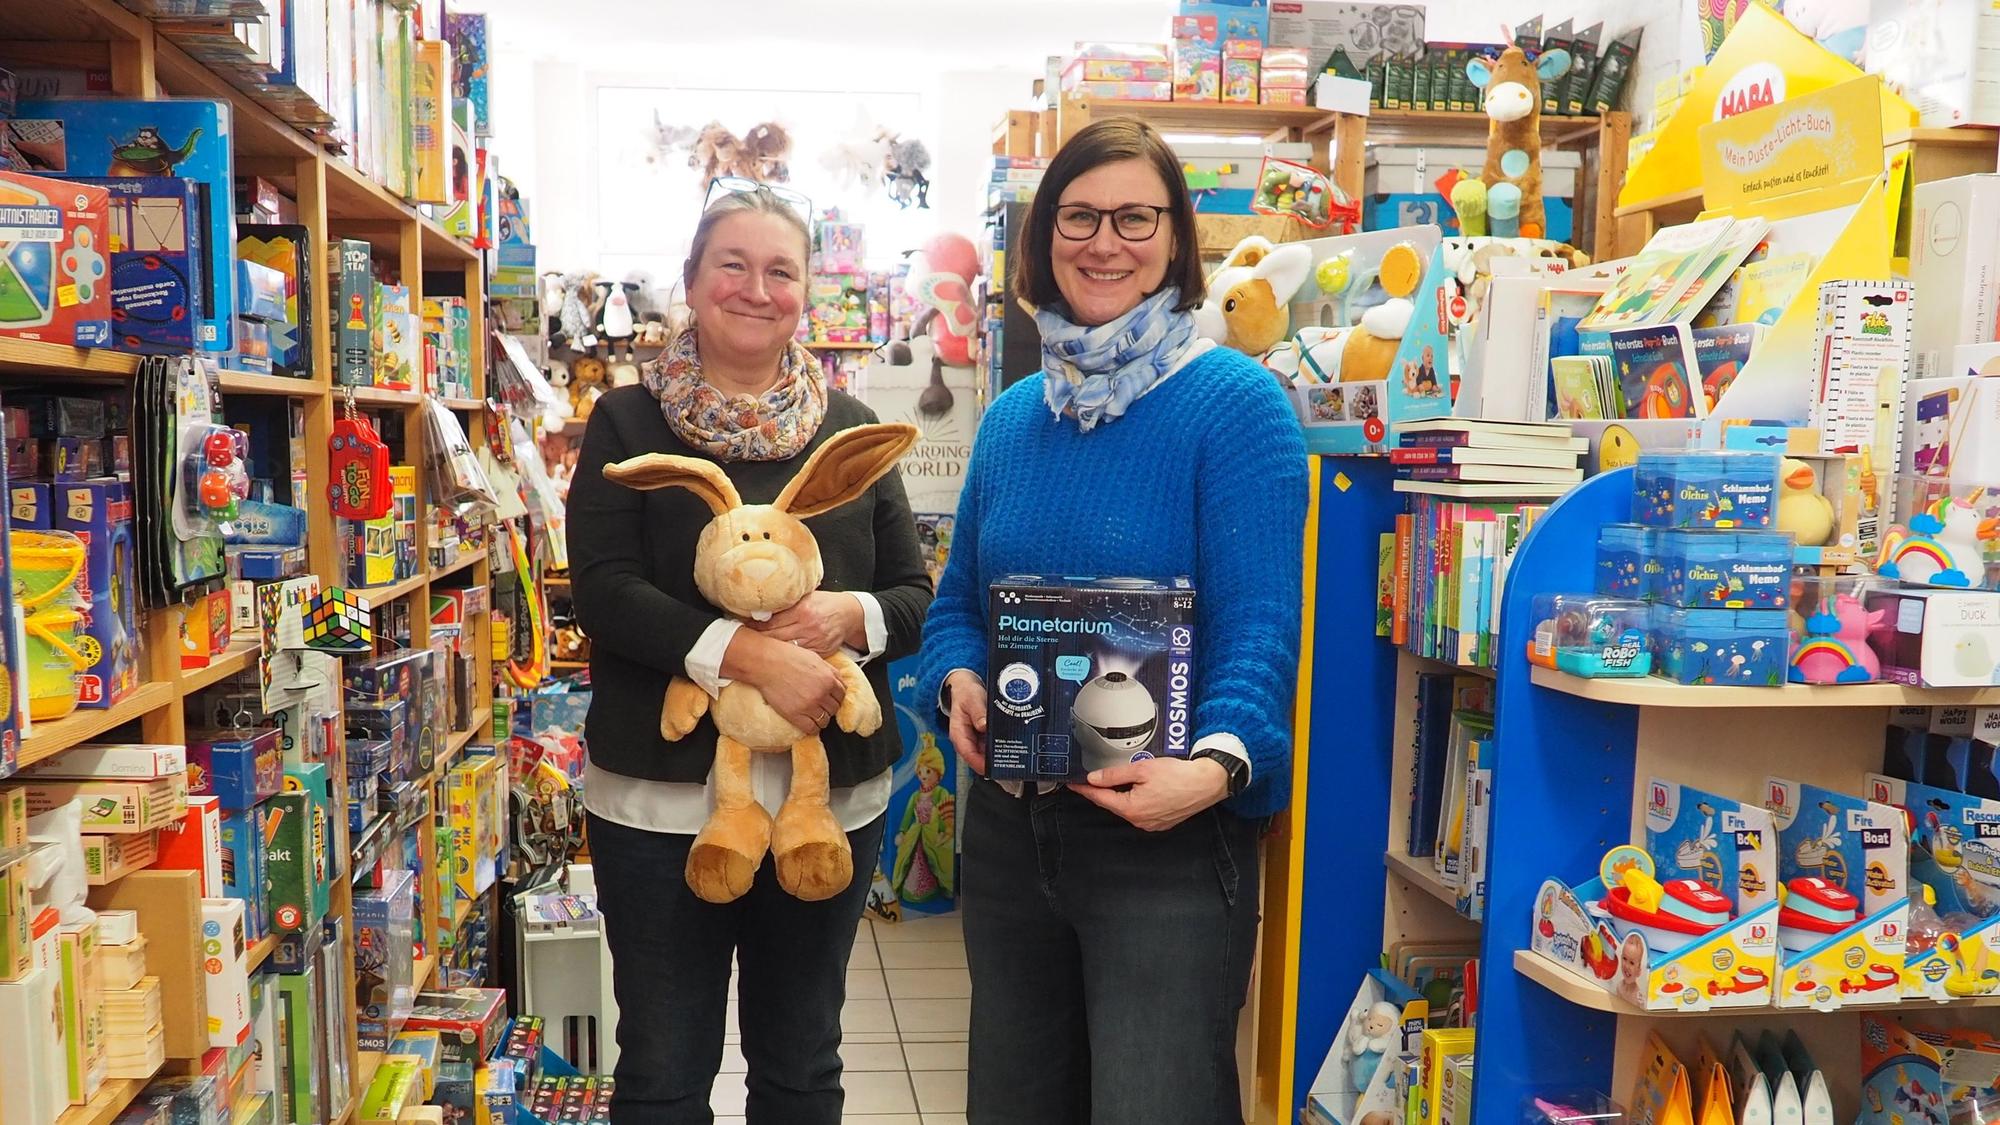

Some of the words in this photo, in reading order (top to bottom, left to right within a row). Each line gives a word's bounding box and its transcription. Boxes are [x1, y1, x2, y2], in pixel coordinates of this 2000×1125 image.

[1721, 78, 1775, 119] HABA
[1725, 146, 1746, 168] Mein
[1747, 114, 1832, 166] Puste-Licht-Buch
[1742, 180, 1762, 193] Einfach
[1783, 173, 1795, 184] und
[1796, 170, 1802, 182] es
[345, 250, 368, 262] TOP
[347, 261, 365, 272] TEN
[1547, 263, 1565, 275] HABA
[1978, 265, 1988, 297] wooden
[1976, 298, 1987, 318] rack
[1975, 319, 1984, 332] for
[1627, 338, 1644, 349] erstes
[908, 445, 970, 461] ARDING
[347, 464, 358, 484] TO
[356, 467, 370, 501] FUN
[1722, 484, 1773, 494] Schlammbad-
[349, 485, 360, 508] GO
[1680, 487, 1709, 501] Olchis
[1738, 494, 1767, 505] Memo
[347, 523, 356, 567] memory
[1688, 568, 1718, 581] Olchis
[1732, 564, 1787, 574] Schlammbad-
[1749, 574, 1780, 585] Memo
[1960, 609, 1987, 620] DUCK
[999, 615, 1113, 635] Planetarium
[998, 634, 1010, 642] Hol
[1012, 635, 1023, 643] dir
[1036, 636, 1059, 644] Sterne
[1621, 641, 1641, 650] REAL
[1009, 643, 1038, 651] Zimmer
[1603, 657, 1632, 668] FISH
[1168, 662, 1188, 750] KOSMOS
[1941, 709, 1968, 718] HAPPY
[1939, 716, 1967, 725] WORLD
[110, 762, 147, 774] Domino
[1728, 814, 1746, 828] Fire
[1854, 814, 1873, 827] Fire
[1965, 810, 2000, 822] Rescue
[452, 830, 462, 851] MAX
[462, 825, 471, 846] MIX
[1736, 832, 1761, 845] Bot
[1863, 831, 1890, 845] Boat
[266, 848, 291, 862] akt
[357, 1039, 385, 1048] SMOS
